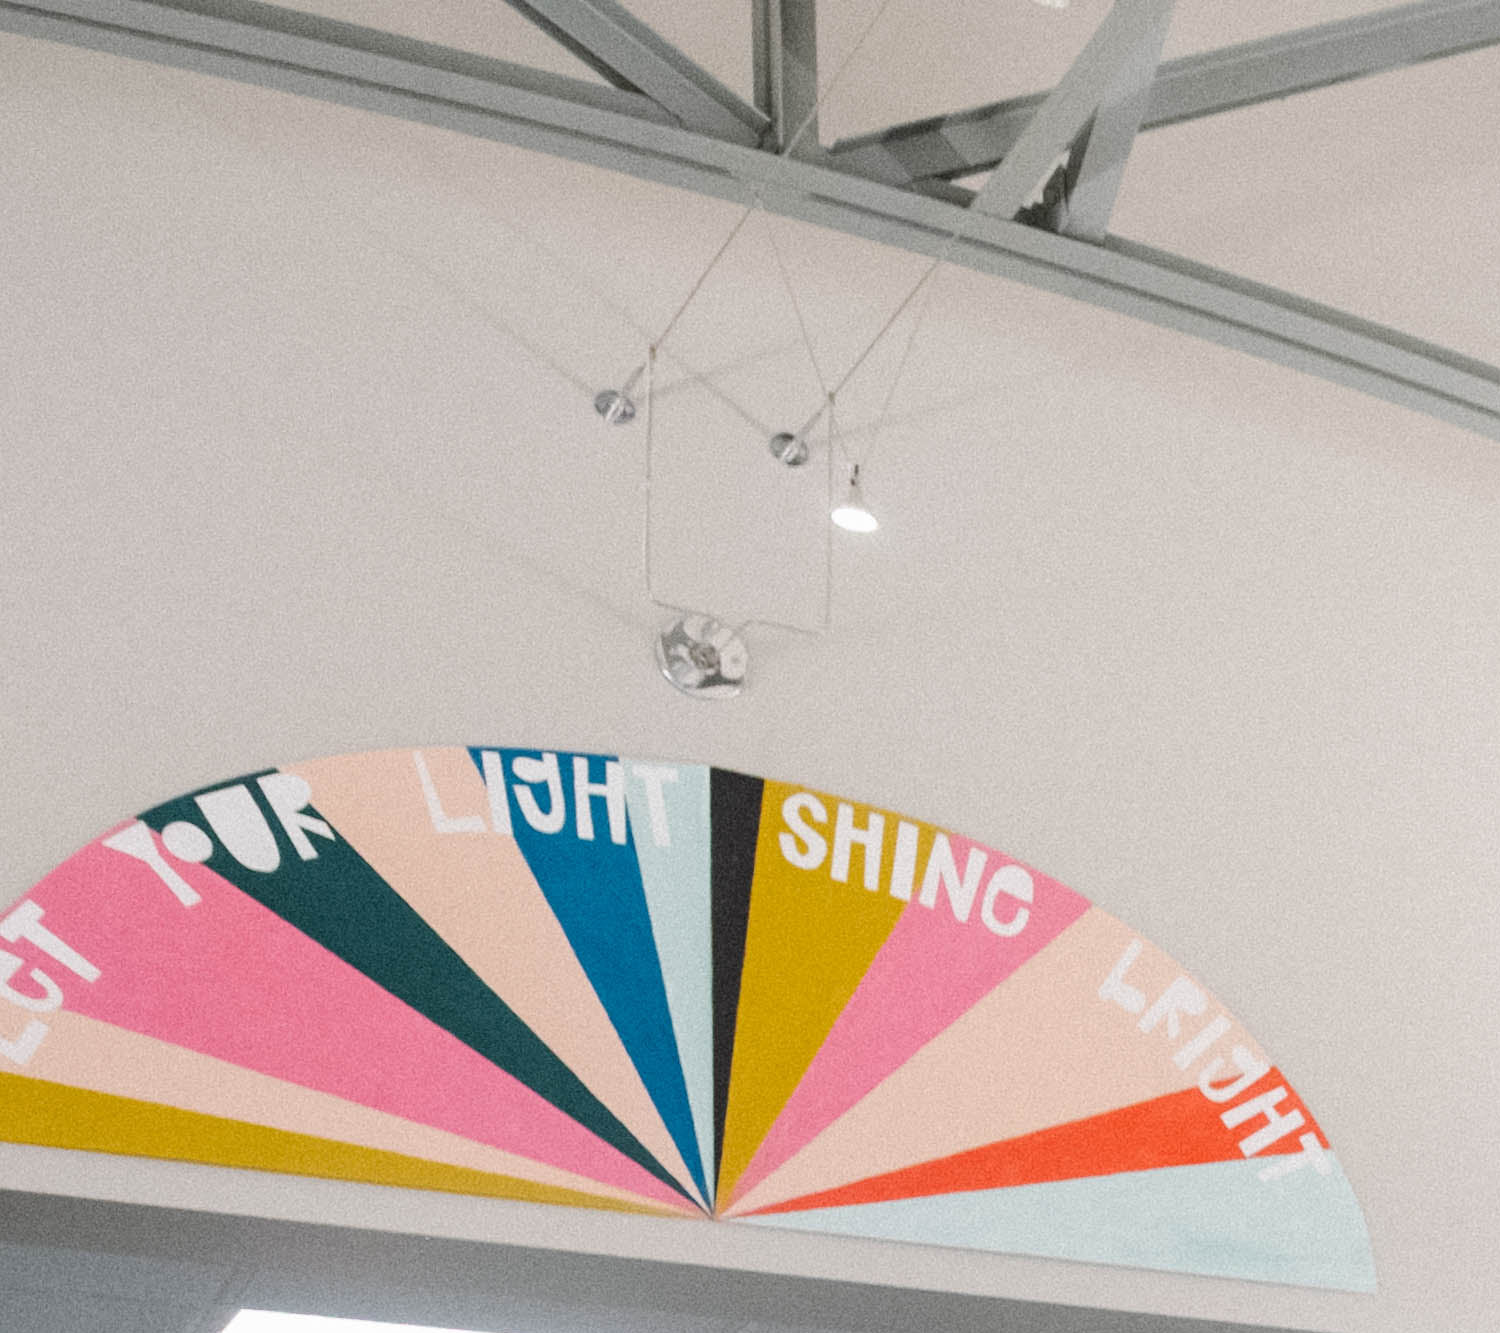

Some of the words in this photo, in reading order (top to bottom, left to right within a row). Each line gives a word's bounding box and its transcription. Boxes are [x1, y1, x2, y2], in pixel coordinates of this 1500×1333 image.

[101, 773, 336, 907] YOUR
[413, 749, 678, 847] LIGHT
[778, 793, 1034, 937] SHINE
